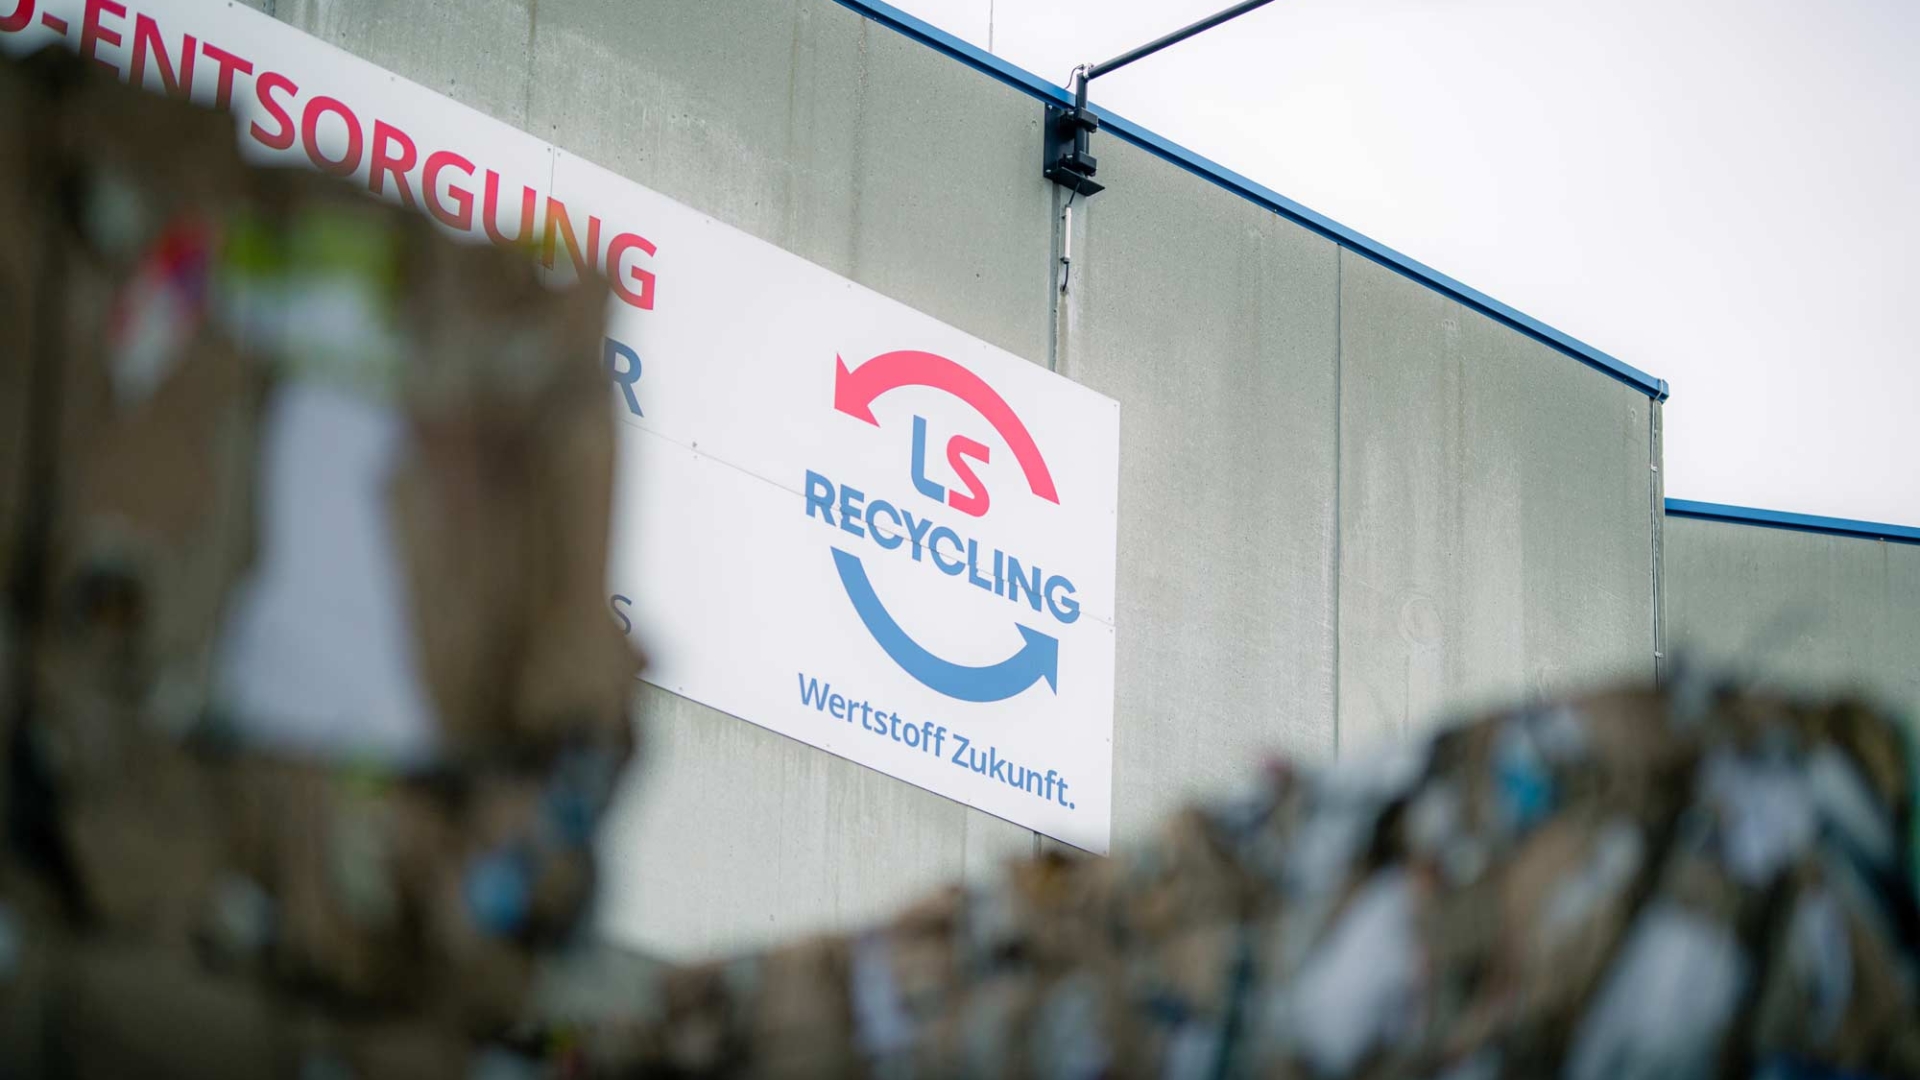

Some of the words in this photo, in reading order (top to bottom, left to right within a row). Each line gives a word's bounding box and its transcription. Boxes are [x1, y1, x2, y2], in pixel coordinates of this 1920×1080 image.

[910, 414, 990, 518] LS
[805, 468, 1081, 625] RECYCLING
[798, 672, 946, 758] Wertstoff
[951, 733, 1076, 810] Zukunft.
